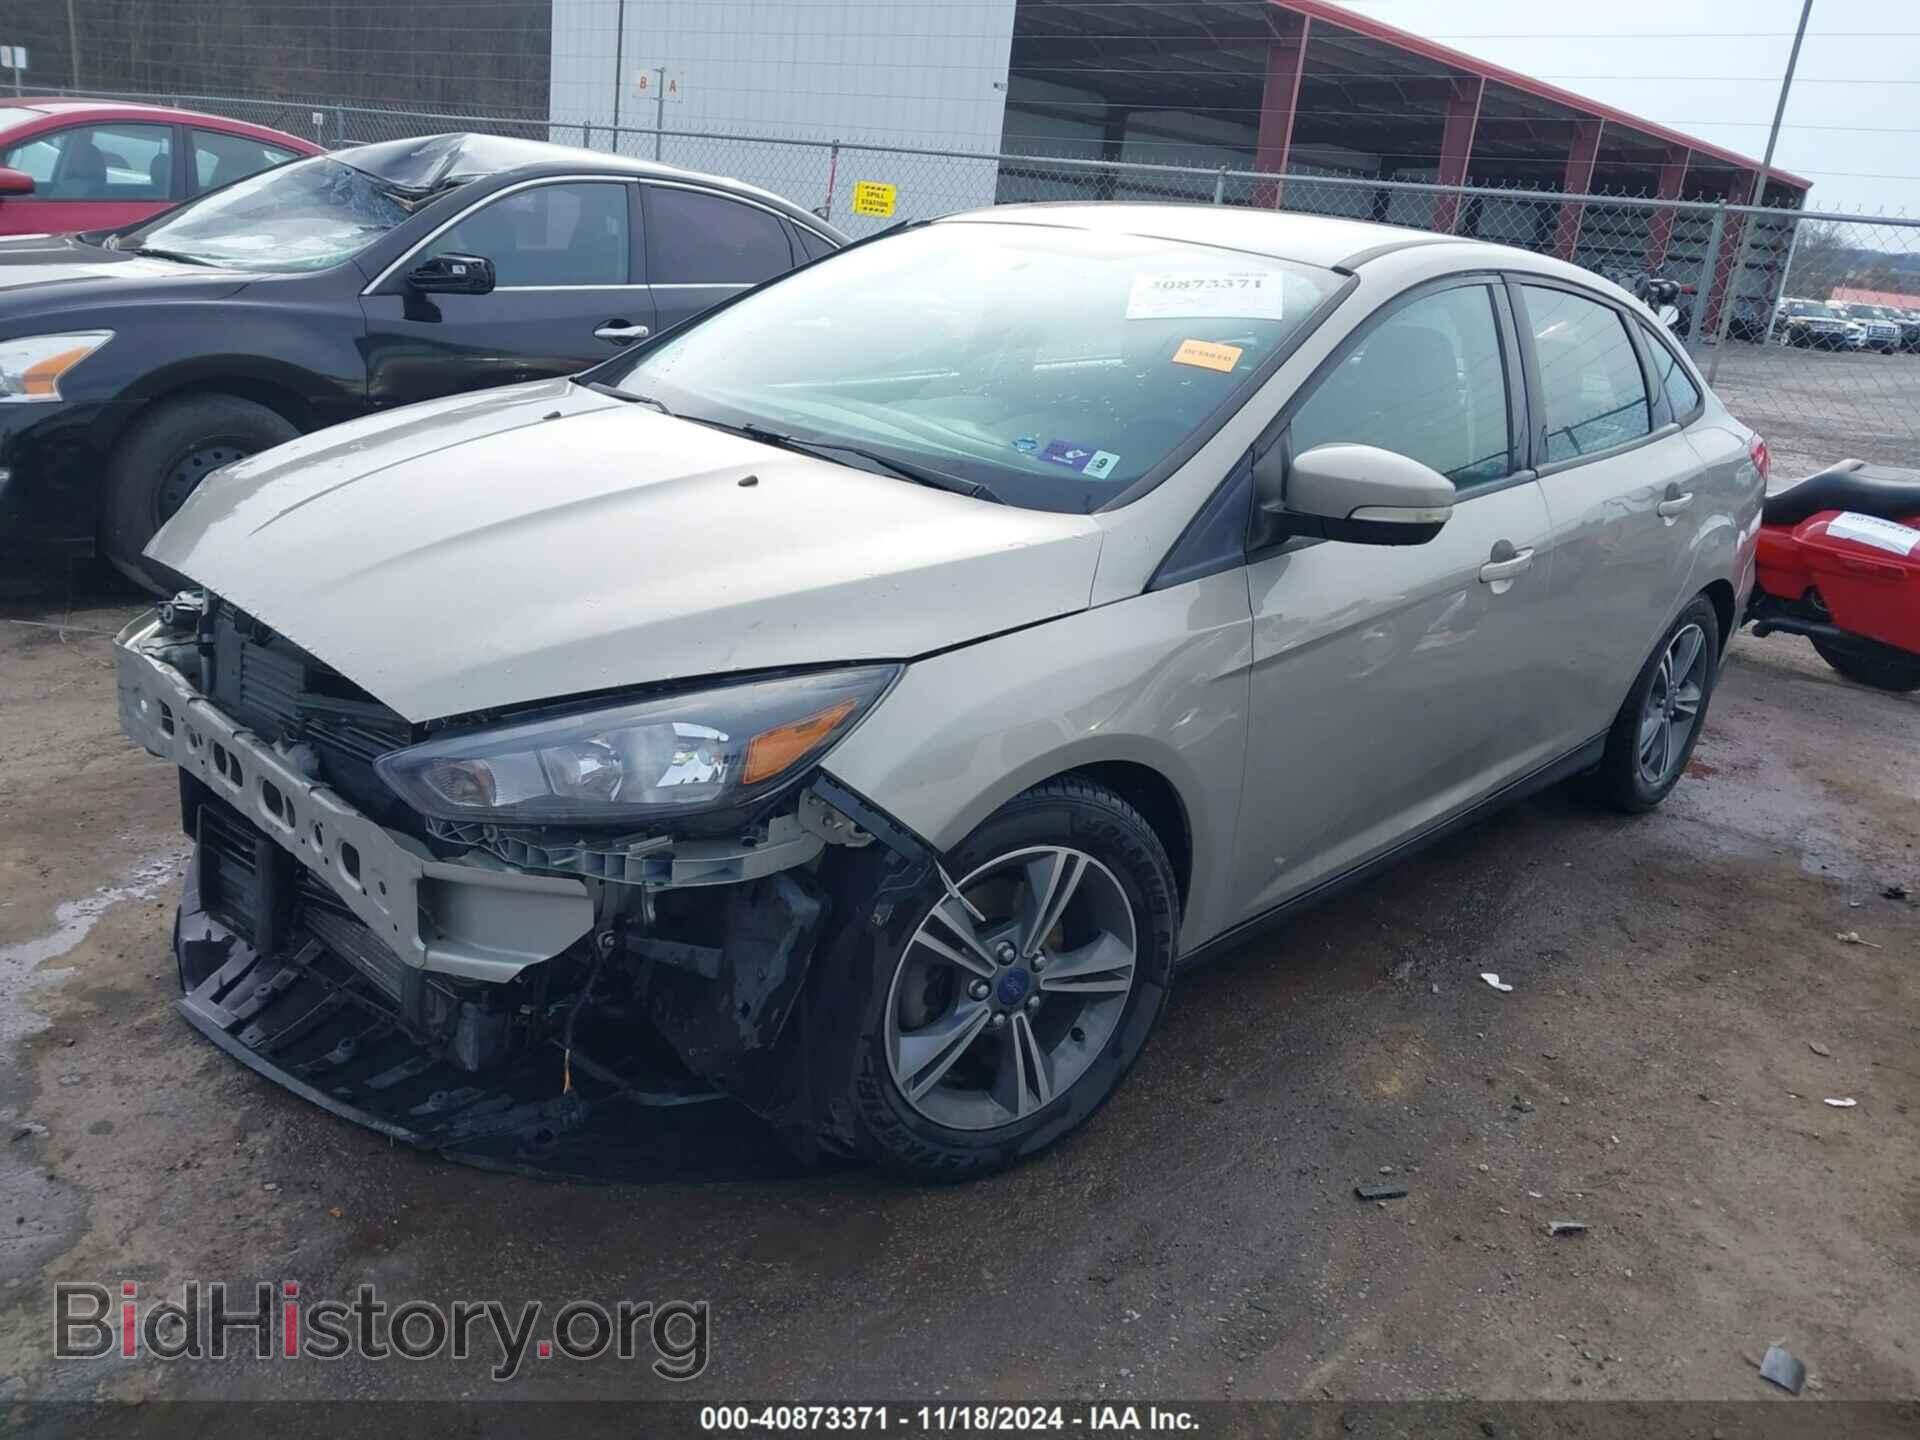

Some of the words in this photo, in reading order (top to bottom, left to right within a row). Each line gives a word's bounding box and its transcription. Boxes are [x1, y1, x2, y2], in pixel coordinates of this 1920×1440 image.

[639, 76, 648, 89] B
[669, 79, 677, 92] A
[866, 191, 884, 199] SPILL
[1096, 457, 1109, 469] 9
